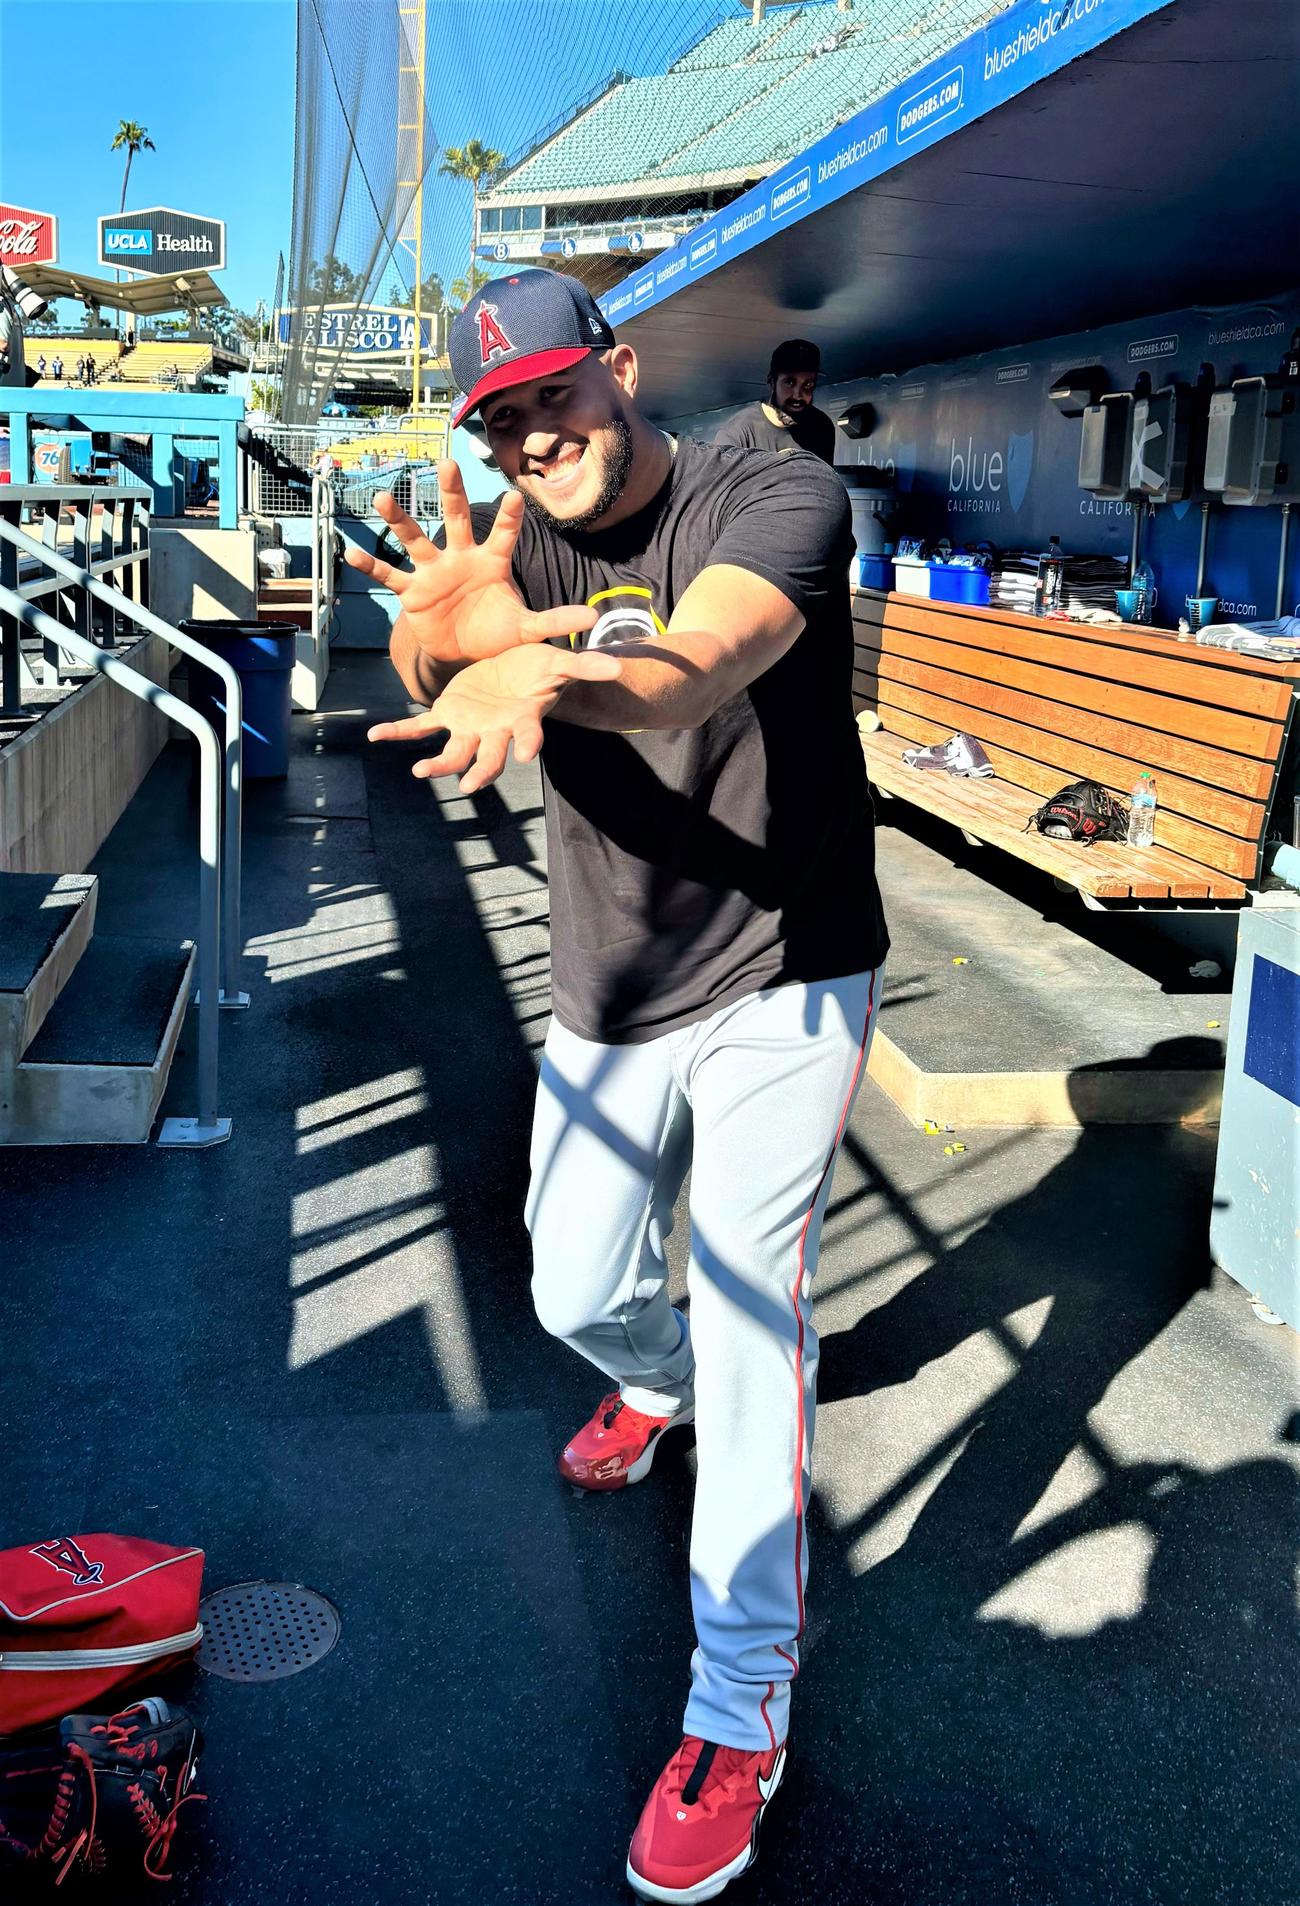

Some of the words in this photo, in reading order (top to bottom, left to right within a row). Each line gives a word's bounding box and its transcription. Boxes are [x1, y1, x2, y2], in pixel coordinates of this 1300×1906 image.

[984, 0, 1104, 81] blueshieldca.co
[900, 80, 959, 131] DODGERS.COM
[818, 125, 888, 183] blueshieldca.com
[773, 177, 809, 210] DODGERS.COM
[721, 203, 767, 244] blueshieldca.com
[108, 234, 148, 250] UCLA
[156, 233, 213, 253] Health
[291, 331, 393, 349] ALISCO
[475, 300, 518, 367] A
[1131, 340, 1175, 357] DODGERS.COM
[1208, 321, 1285, 345] blueshieldca.com
[42, 451, 59, 465] 76
[949, 436, 1003, 492] blue
[947, 499, 1001, 512] CALIFORNIA
[1190, 602, 1201, 631] PRIME
[29, 1537, 104, 1585] A
